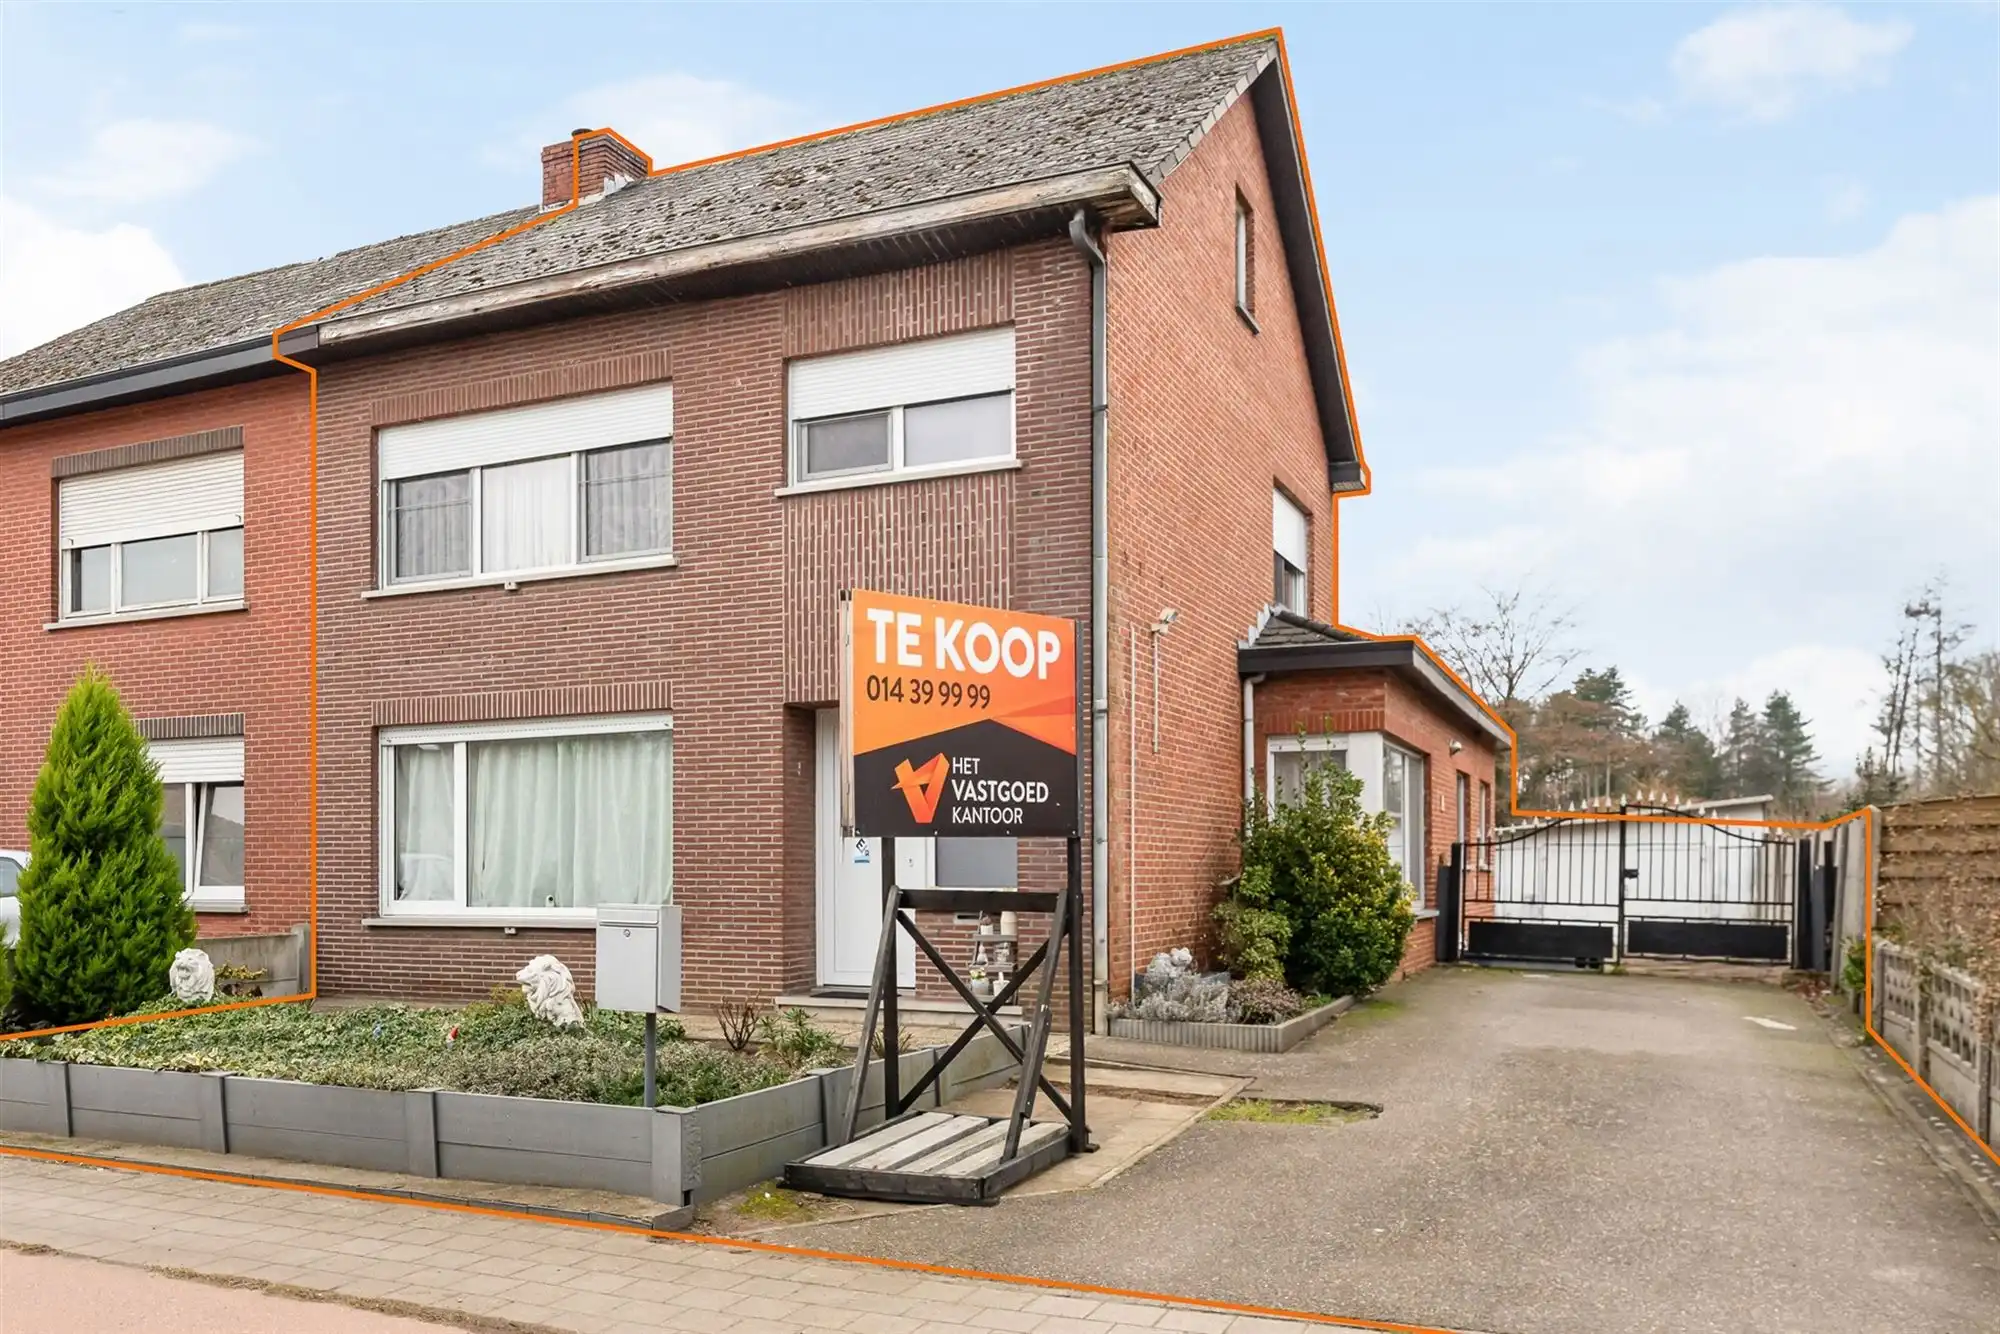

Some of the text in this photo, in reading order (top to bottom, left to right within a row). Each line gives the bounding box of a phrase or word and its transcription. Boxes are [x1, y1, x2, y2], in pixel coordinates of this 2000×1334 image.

[866, 608, 1061, 680] TE KOOP
[866, 674, 990, 709] 014 39 99 99
[952, 757, 980, 774] HET
[951, 779, 1049, 803] VASTGOED
[952, 807, 1023, 824] KANTOOR
